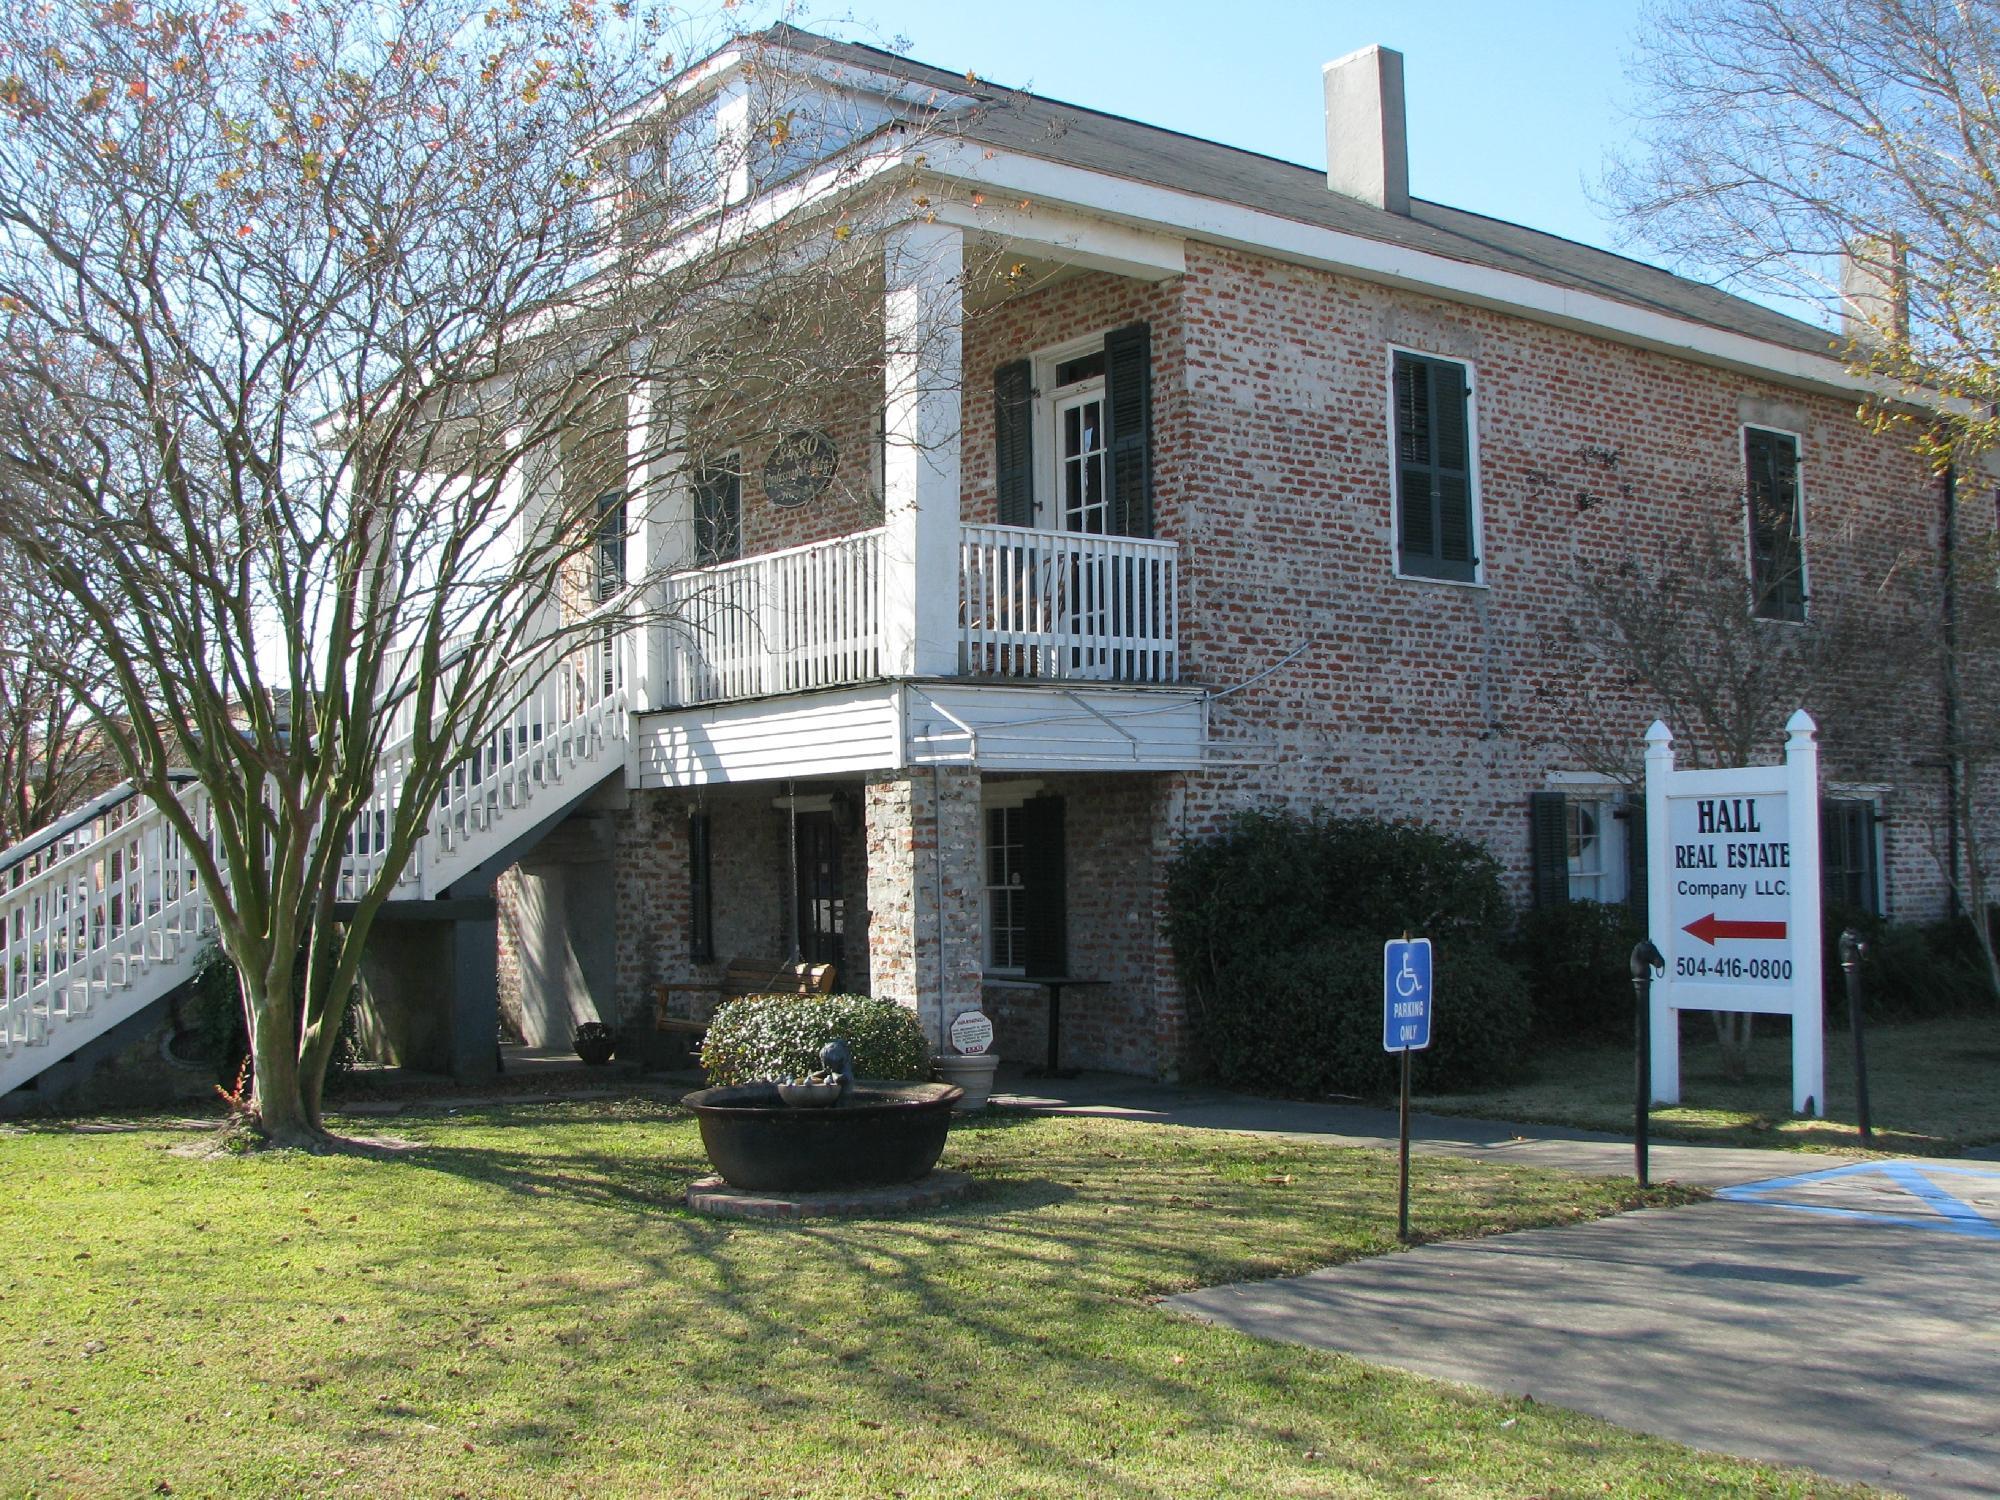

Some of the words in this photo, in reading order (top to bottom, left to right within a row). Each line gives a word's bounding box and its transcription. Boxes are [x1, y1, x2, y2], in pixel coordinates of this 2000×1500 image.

[1697, 798, 1761, 834] HALL
[1675, 844, 1718, 869] REAL
[1727, 842, 1791, 868] ESTATE
[1677, 880, 1748, 899] Company
[1755, 880, 1791, 896] LLC.
[1676, 956, 1793, 980] 504-416-0800
[1393, 1000, 1424, 1018] PARKING
[1400, 1024, 1418, 1041] ONLY
